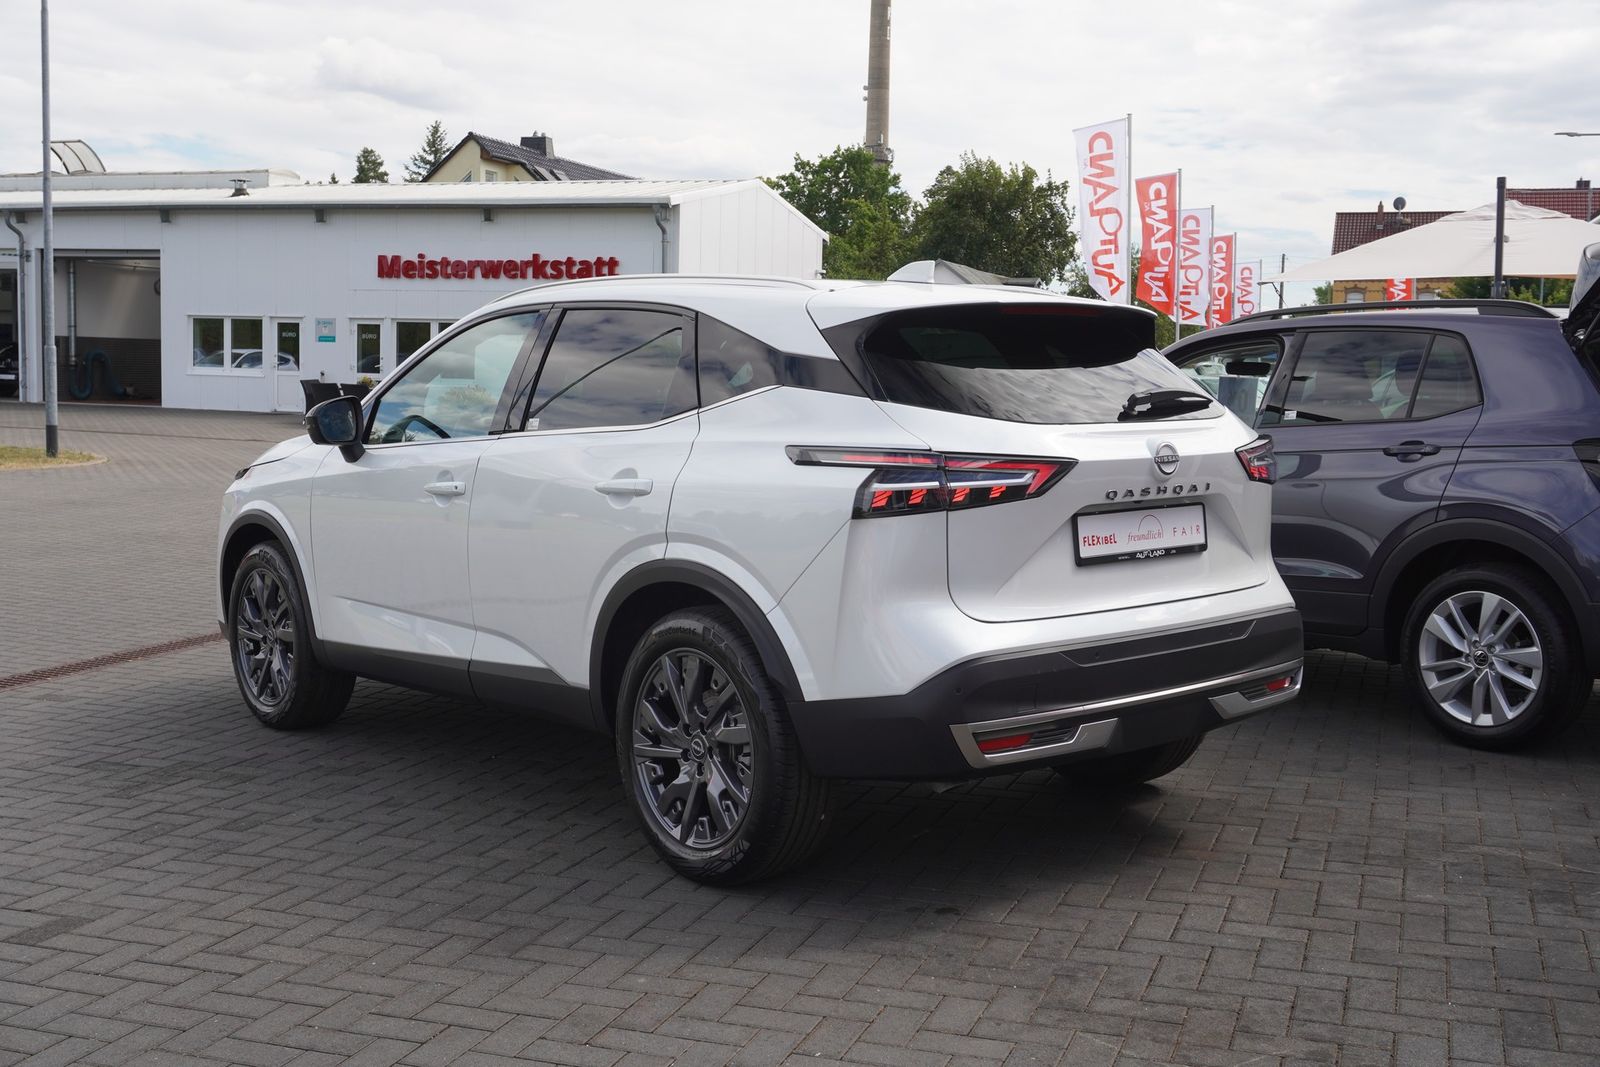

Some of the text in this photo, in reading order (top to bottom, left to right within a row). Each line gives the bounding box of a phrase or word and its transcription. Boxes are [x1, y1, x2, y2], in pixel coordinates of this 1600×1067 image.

[377, 253, 620, 280] Meisterwerkstatt
[1154, 455, 1180, 463] NISSAN
[1106, 483, 1211, 500] QASHQAI
